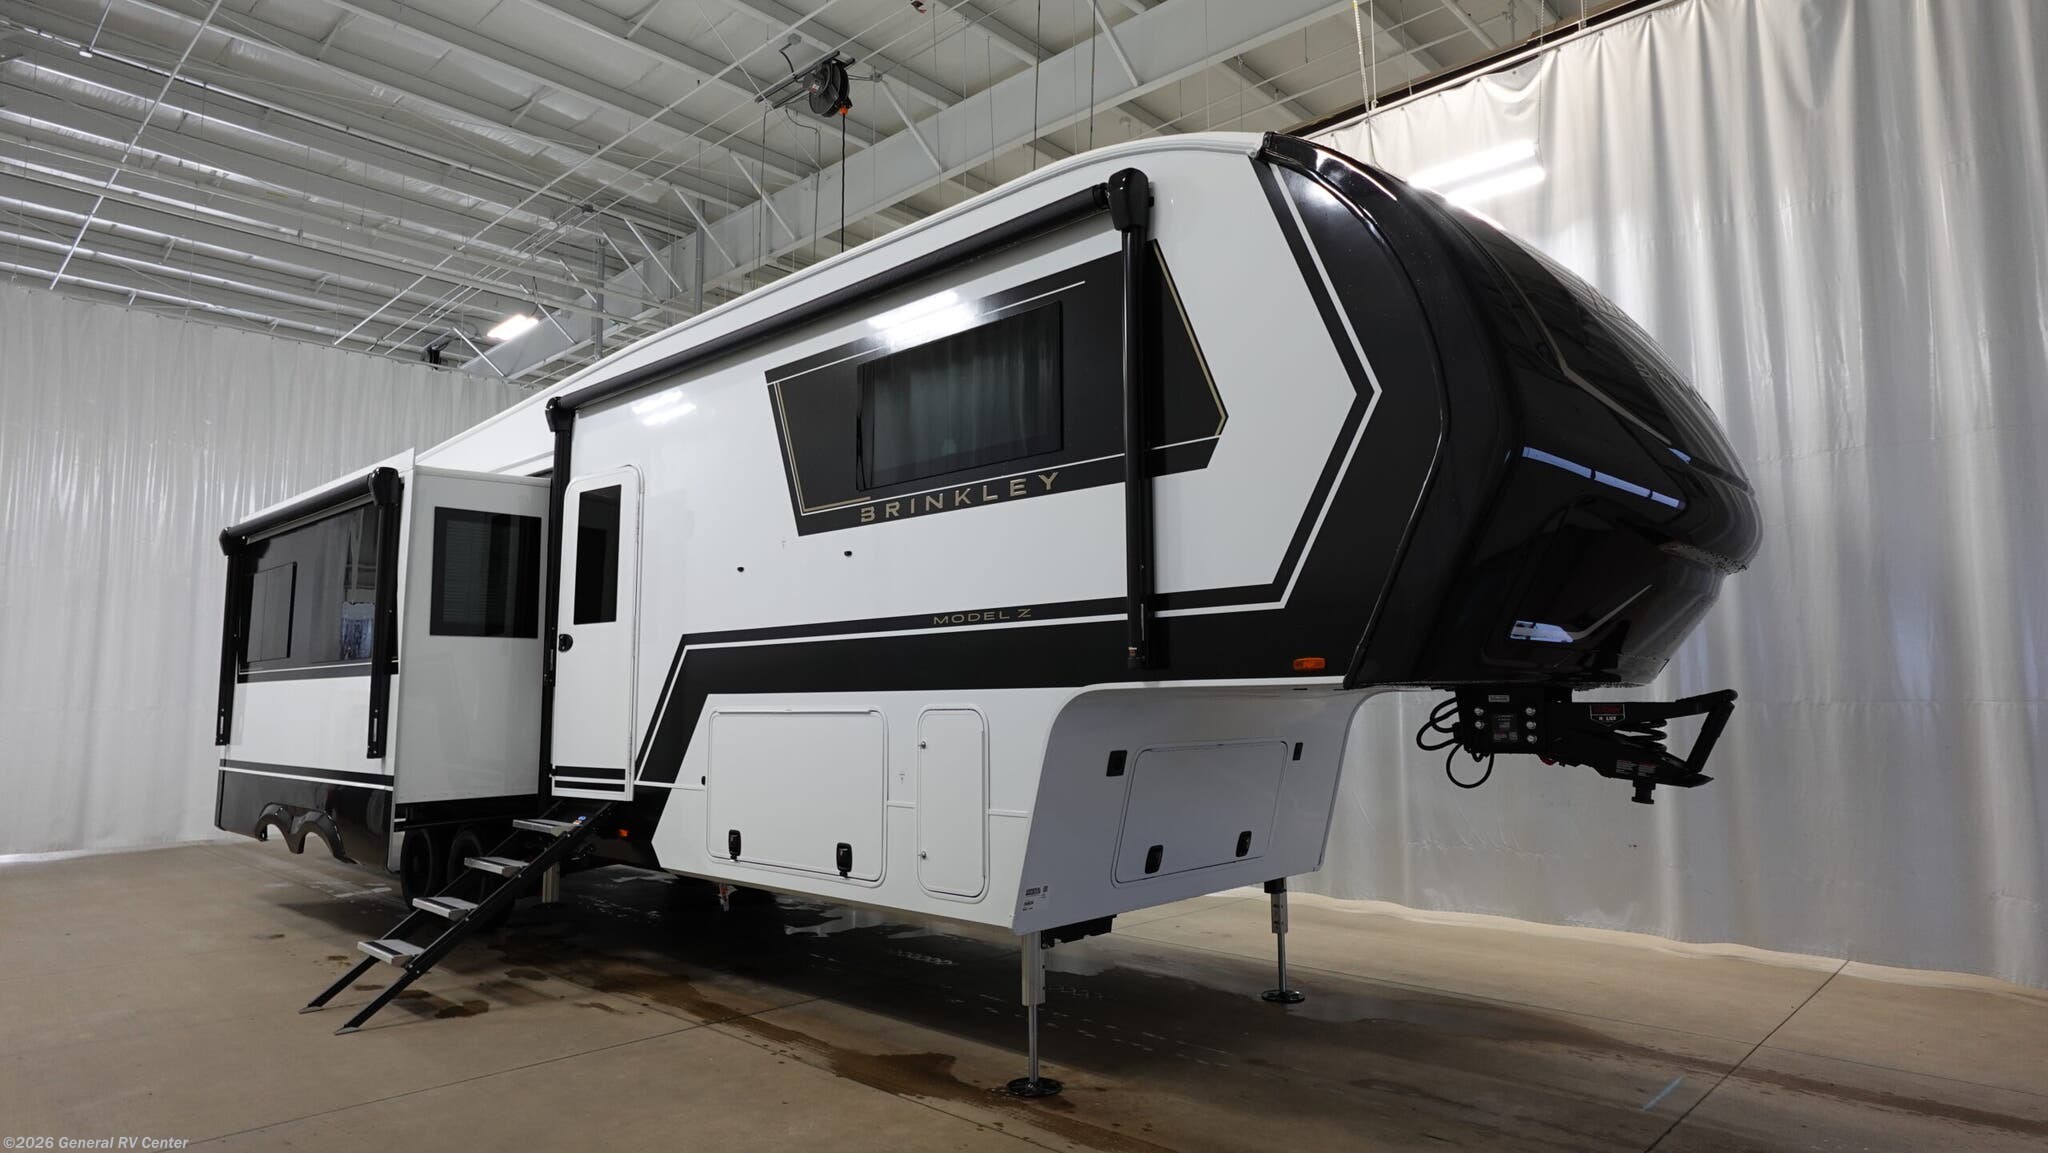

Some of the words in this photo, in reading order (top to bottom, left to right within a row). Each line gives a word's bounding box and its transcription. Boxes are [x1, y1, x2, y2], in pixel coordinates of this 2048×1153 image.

[861, 471, 1059, 523] BRINKLEY
[933, 610, 1010, 625] MODEL
[1017, 608, 1032, 618] Z
